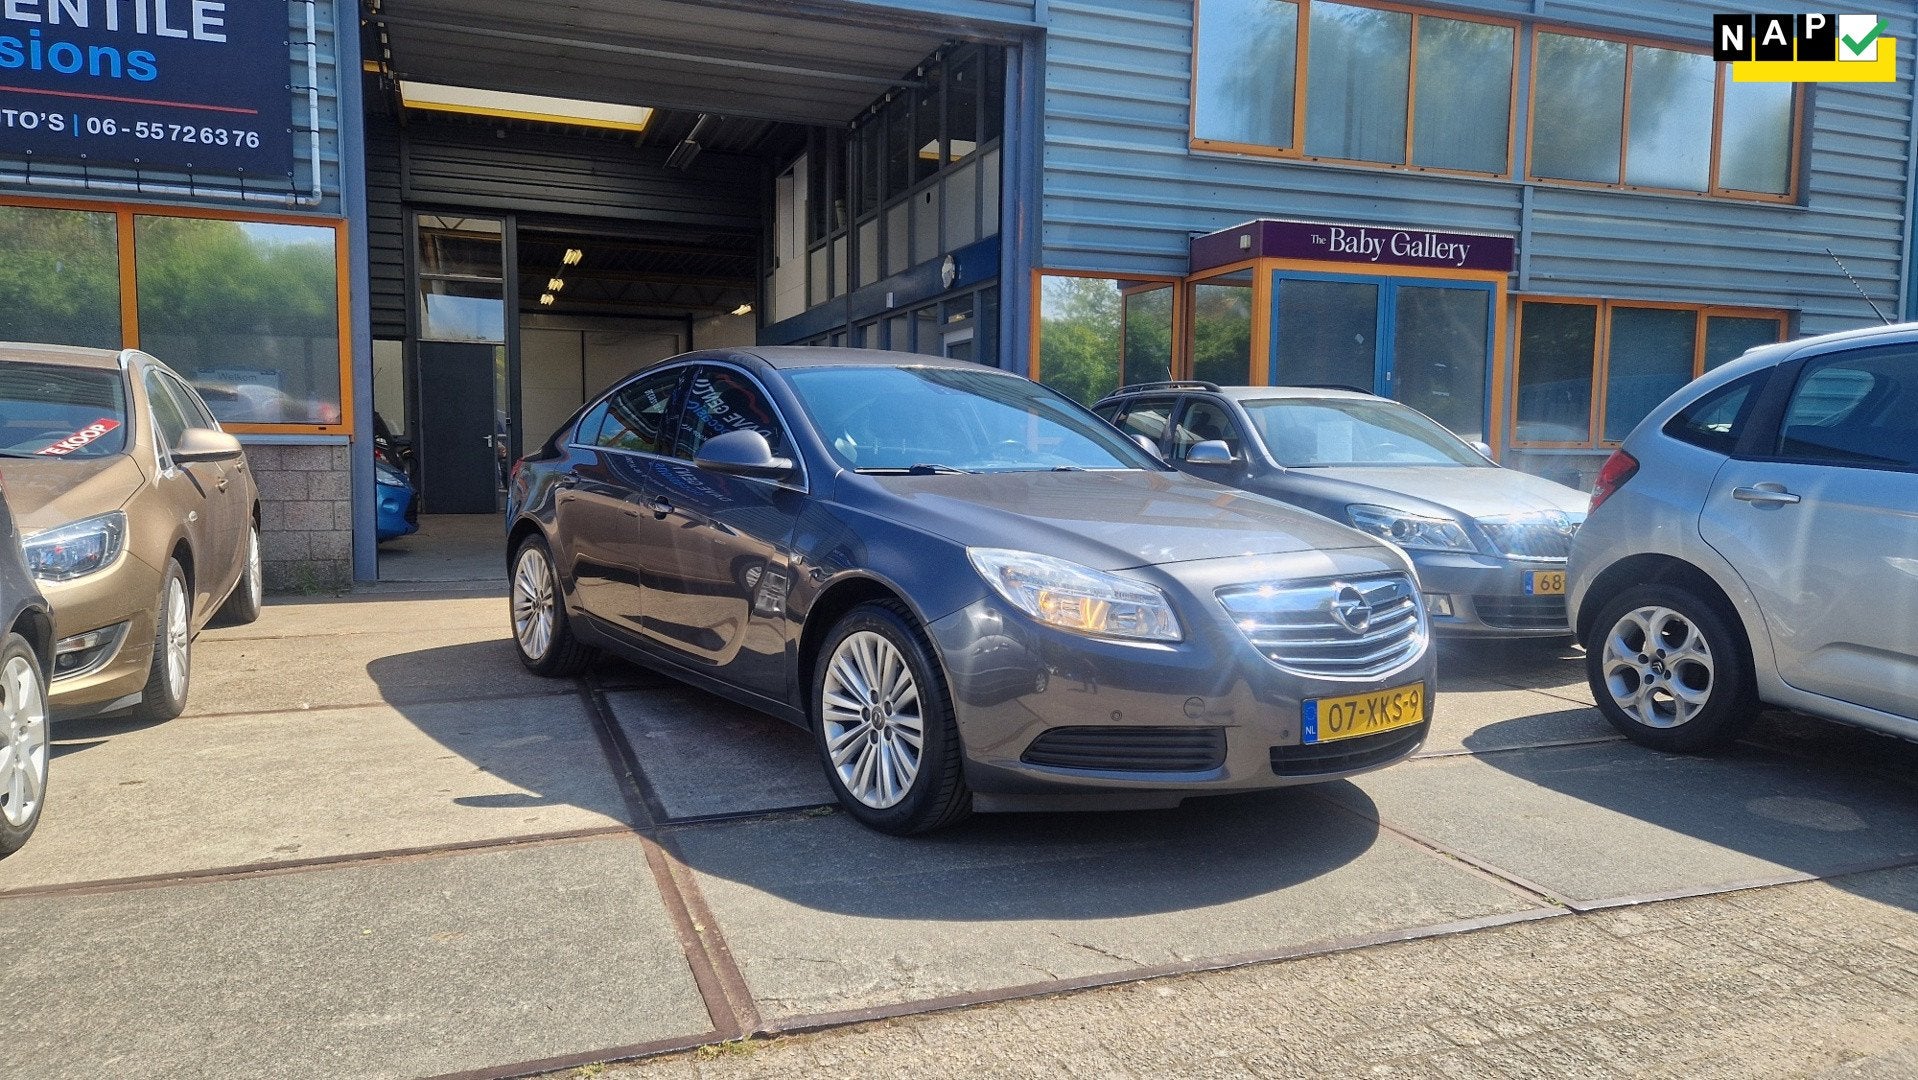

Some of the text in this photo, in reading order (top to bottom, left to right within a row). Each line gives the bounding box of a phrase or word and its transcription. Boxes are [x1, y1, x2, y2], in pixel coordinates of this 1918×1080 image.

[0, 28, 158, 82] sions
[0, 109, 66, 131] TO'S
[1311, 227, 1470, 266] The Baby Gallery
[1305, 690, 1419, 735] NL 07-XKS-9
